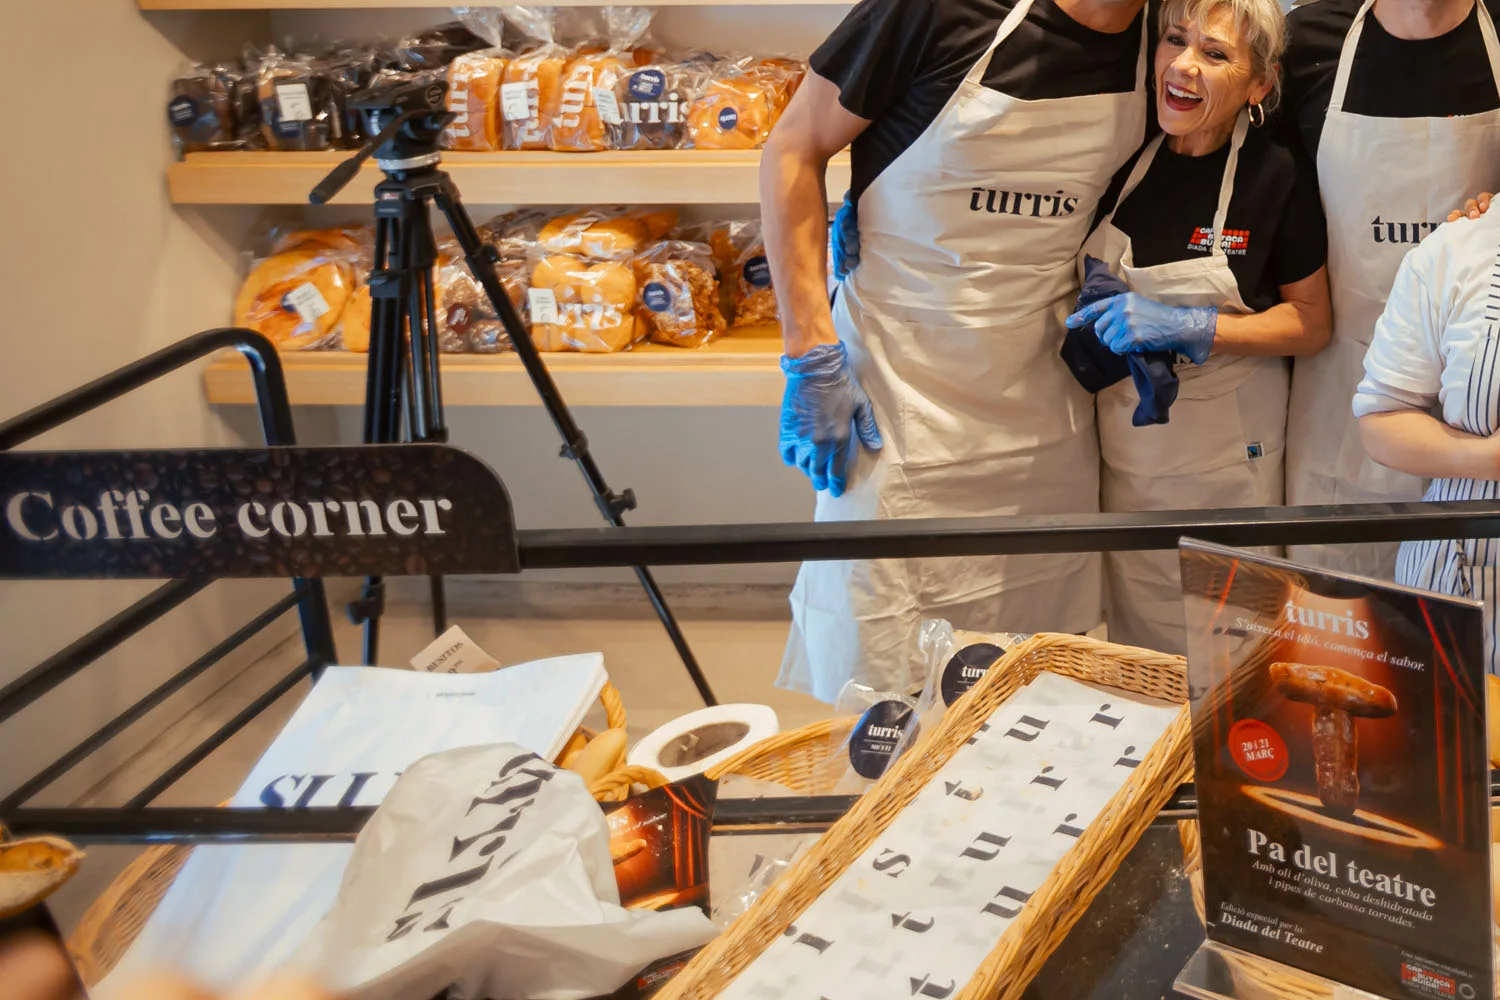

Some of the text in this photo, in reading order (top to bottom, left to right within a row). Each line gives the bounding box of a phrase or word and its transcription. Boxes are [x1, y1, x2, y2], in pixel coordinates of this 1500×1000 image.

[969, 187, 1079, 218] turris
[1207, 234, 1243, 243] BTACA
[6, 488, 454, 541] Coffee corner
[1285, 599, 1369, 640] turris
[1284, 630, 1295, 640] el
[1324, 641, 1374, 662] comença
[1377, 651, 1388, 662] el
[1390, 656, 1425, 671] sabor.
[868, 723, 904, 738] turris
[1242, 741, 1253, 751] 20
[1259, 738, 1269, 748] 21
[1246, 747, 1275, 762] MARÇ
[1247, 828, 1436, 907] Pa del teatre
[1252, 860, 1433, 921] Amb oli d'oliva, ceba deshidratada
[1274, 879, 1301, 893] pipes
[1304, 888, 1317, 898] de
[1318, 894, 1366, 913] carbassa
[1368, 908, 1416, 928] torrades.
[1221, 901, 1245, 916] Edició
[1246, 910, 1279, 926] especial
[1280, 921, 1293, 932] per
[1221, 912, 1324, 953] Diada del Teatre
